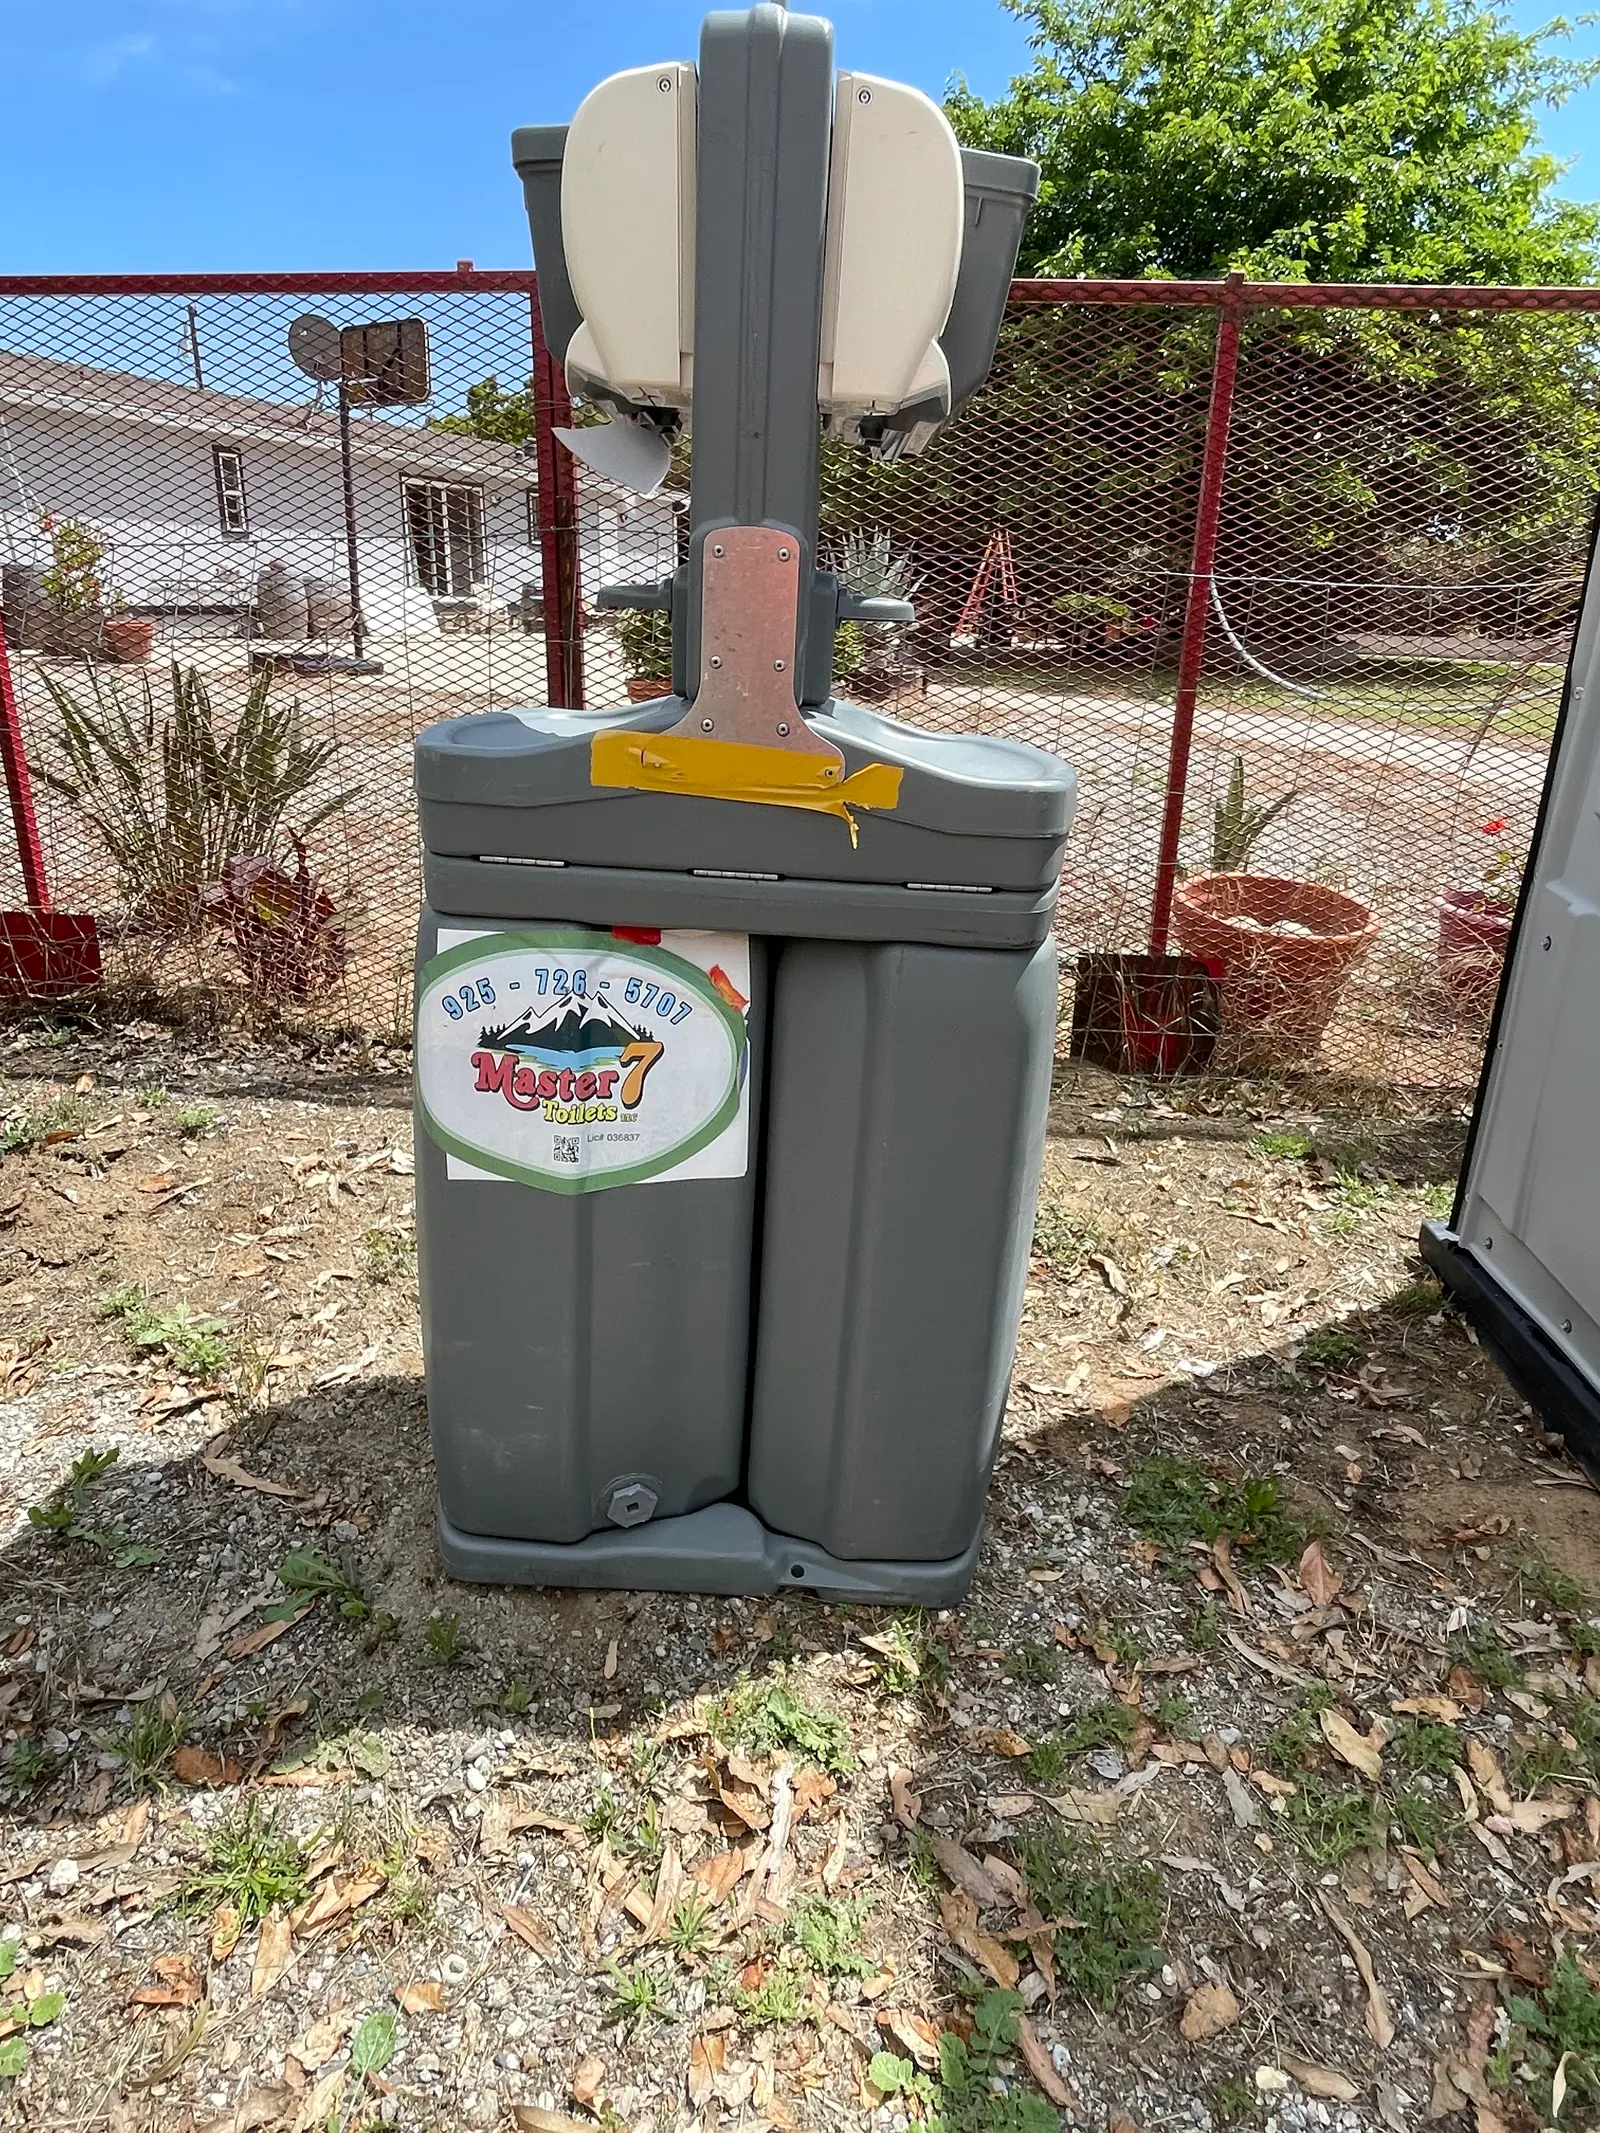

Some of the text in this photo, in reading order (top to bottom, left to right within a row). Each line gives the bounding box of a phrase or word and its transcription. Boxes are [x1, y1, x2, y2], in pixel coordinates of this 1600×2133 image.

[442, 978, 496, 1020] 925
[535, 969, 587, 995] 726
[624, 977, 693, 1026] 5707
[471, 1041, 664, 1110] Master 7
[542, 1100, 617, 1125] Toilets
[587, 1133, 604, 1143] Lic#
